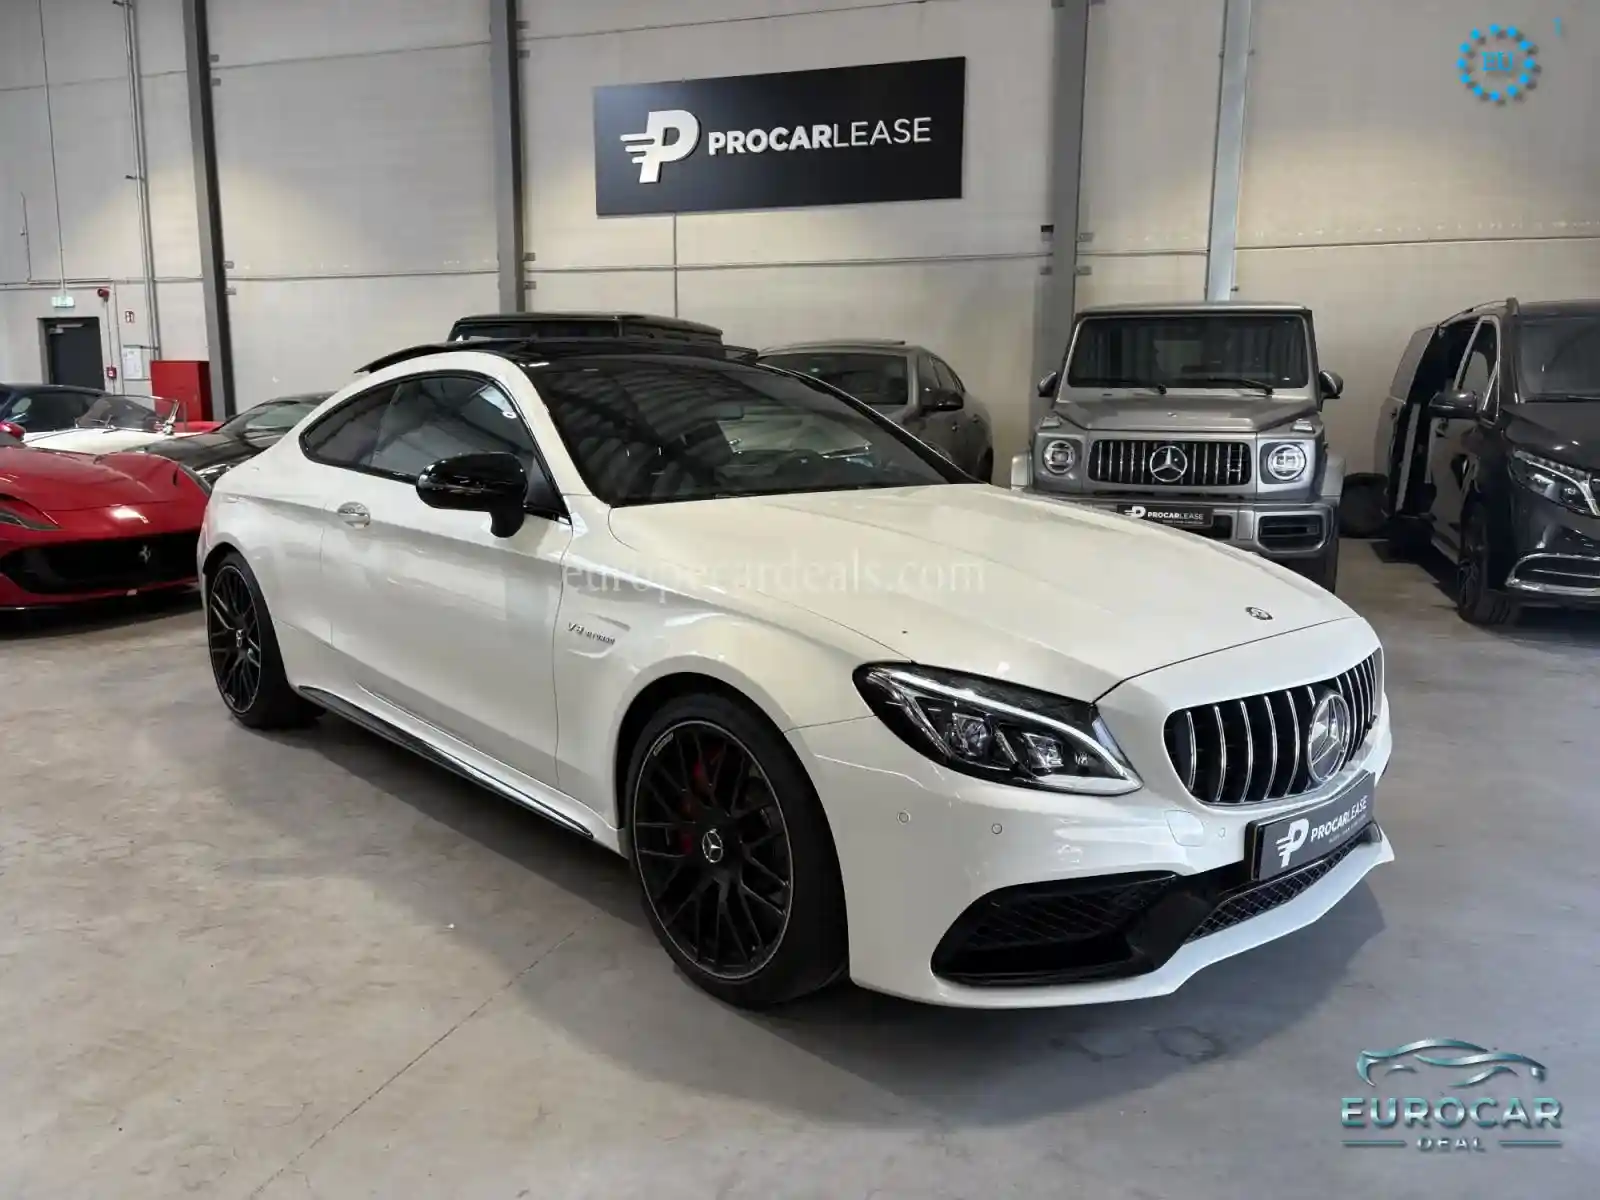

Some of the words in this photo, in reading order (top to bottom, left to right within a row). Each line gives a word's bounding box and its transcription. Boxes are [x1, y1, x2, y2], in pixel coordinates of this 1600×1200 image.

[708, 117, 932, 156] PROCARLEASE
[1147, 511, 1204, 520] PROCARLEASE
[1310, 794, 1368, 843] PROCARLEASE
